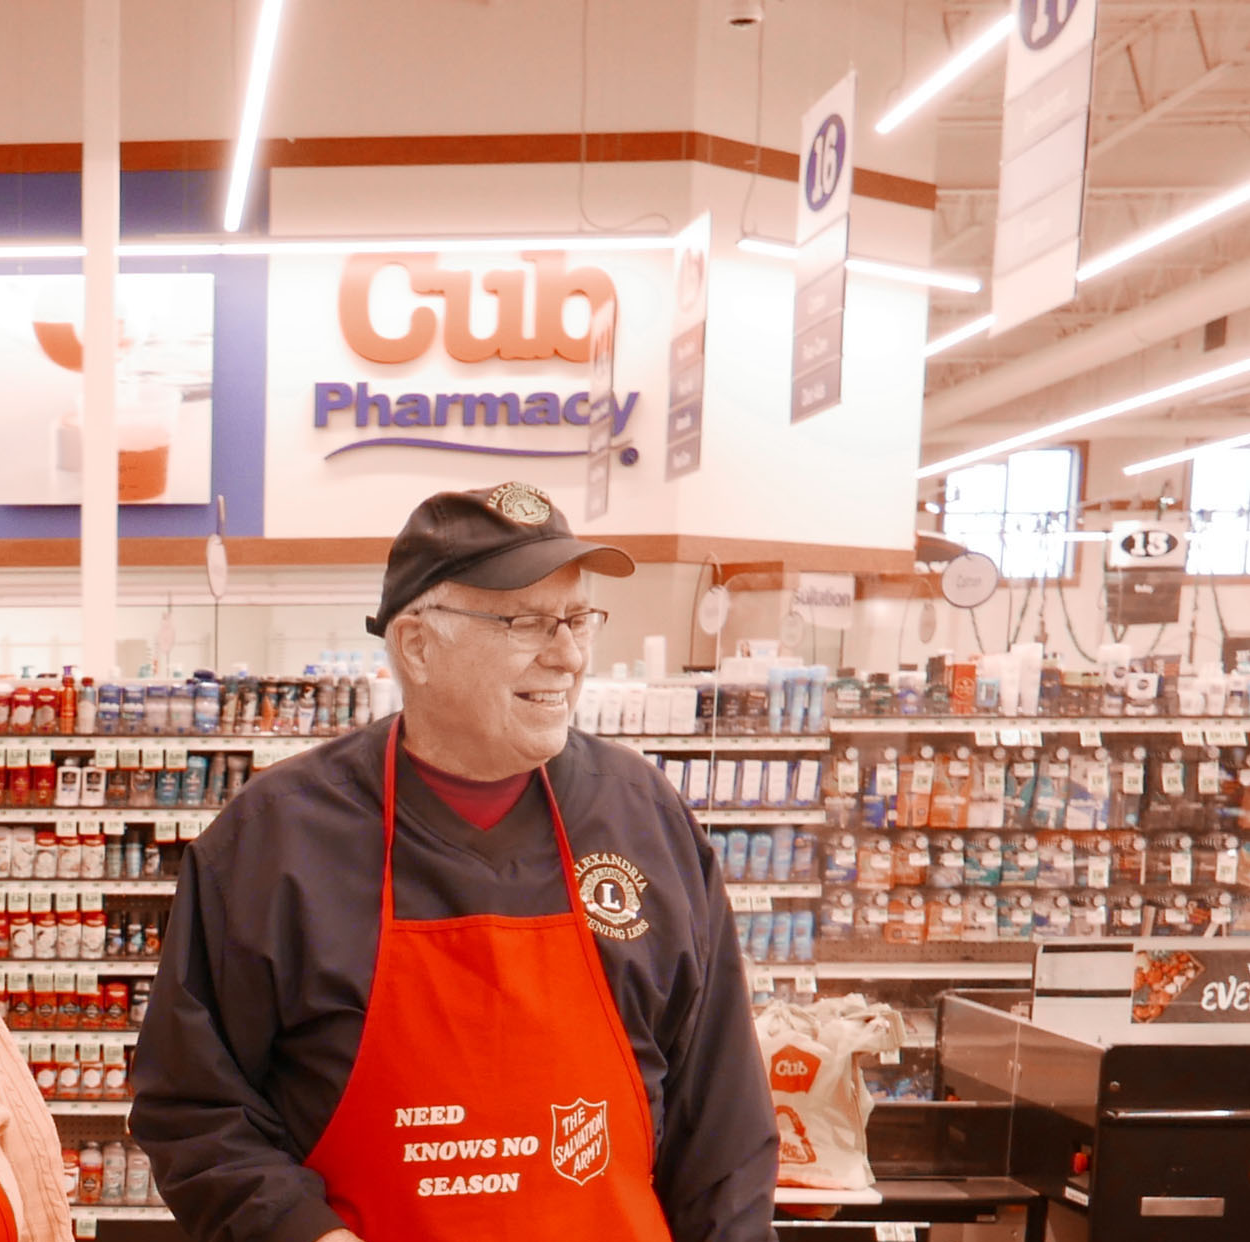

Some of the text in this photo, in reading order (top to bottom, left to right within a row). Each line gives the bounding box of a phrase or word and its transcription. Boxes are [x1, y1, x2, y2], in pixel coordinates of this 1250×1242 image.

[811, 121, 839, 203] 16
[338, 250, 618, 364] Cub
[314, 381, 640, 437] Pharmacy
[1130, 531, 1169, 557] 15
[601, 883, 622, 909] L
[1201, 975, 1250, 1011] EVE
[775, 1060, 808, 1076] Cub
[394, 1105, 465, 1127] NEED
[561, 1106, 586, 1136] THE
[403, 1136, 539, 1162] KNOWS NO
[554, 1109, 603, 1167] SALVATION
[573, 1134, 603, 1177] ARMY
[417, 1173, 521, 1197] SEASON
